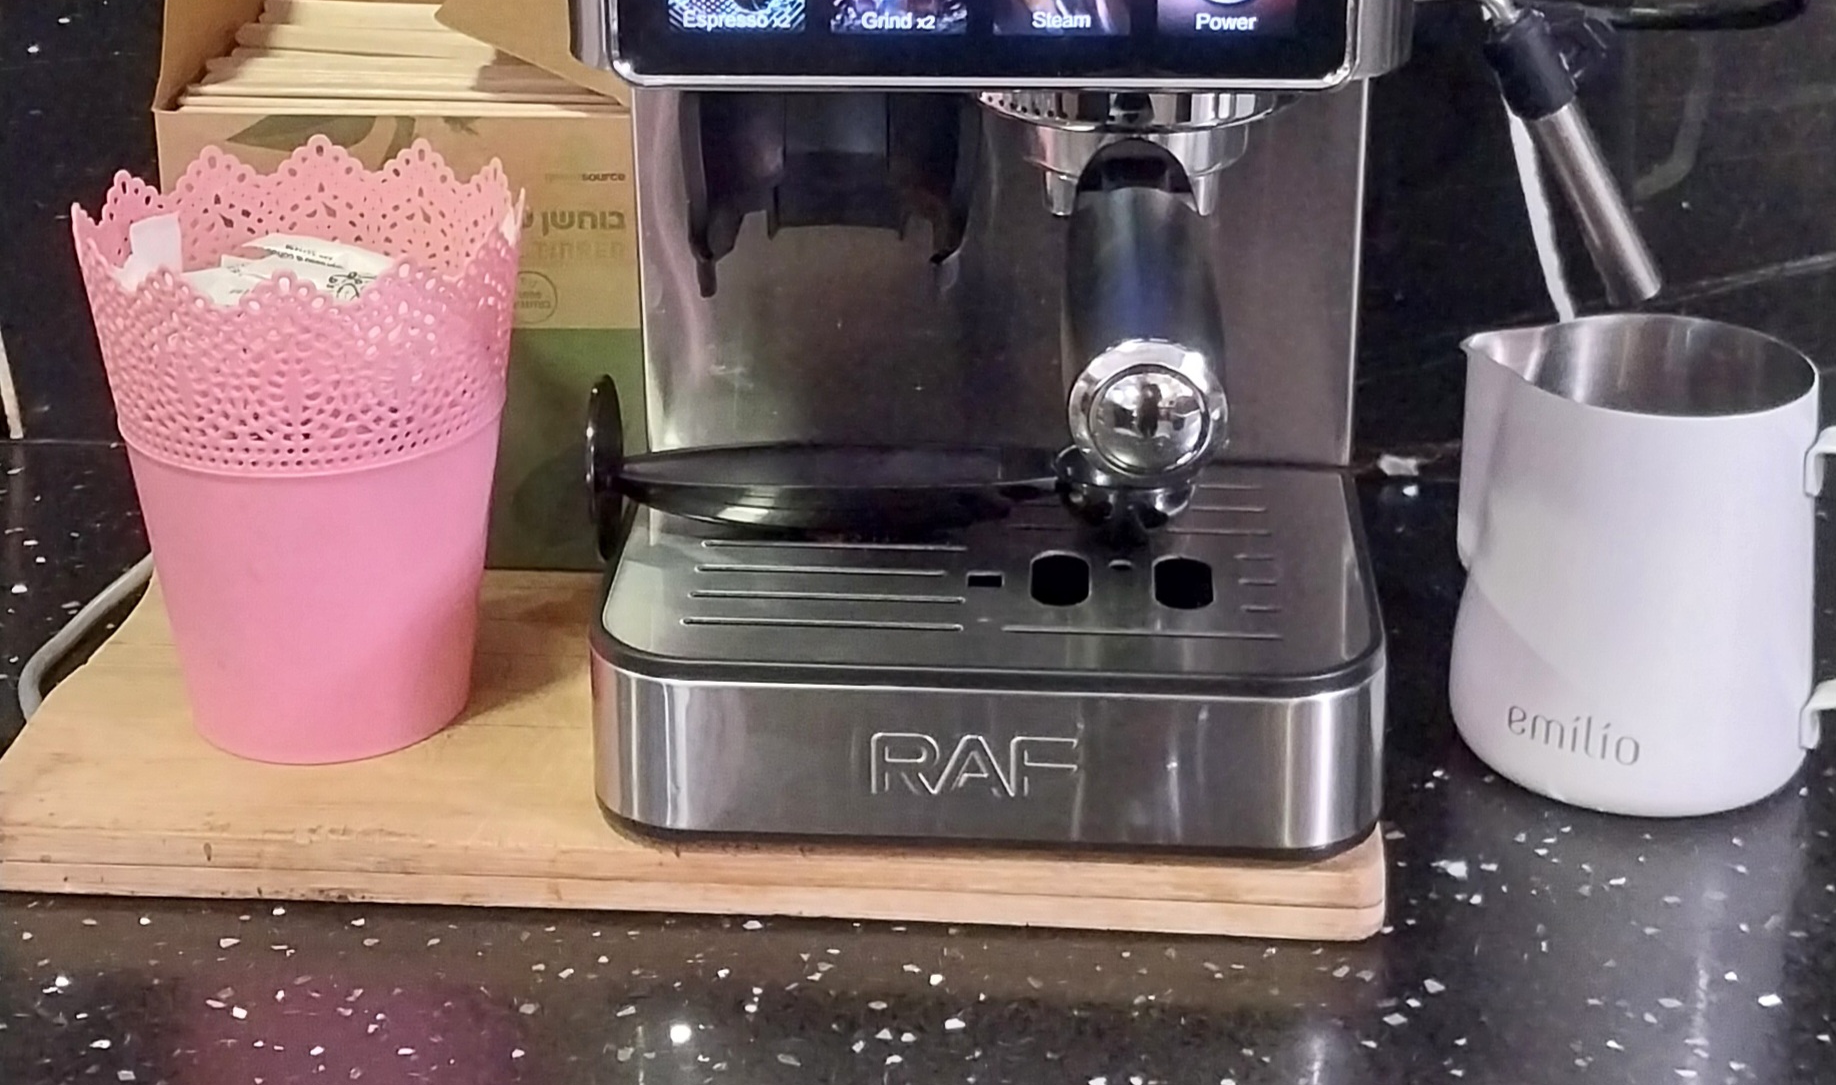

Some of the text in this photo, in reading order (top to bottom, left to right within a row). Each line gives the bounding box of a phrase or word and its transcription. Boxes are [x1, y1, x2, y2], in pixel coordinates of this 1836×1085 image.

[682, 12, 791, 32] Espresso x2
[861, 11, 936, 30] Grind x2
[1031, 11, 1092, 29] Steam
[1195, 12, 1257, 31] Power
[541, 210, 626, 237] בוחשן
[870, 731, 1080, 798] RAF
